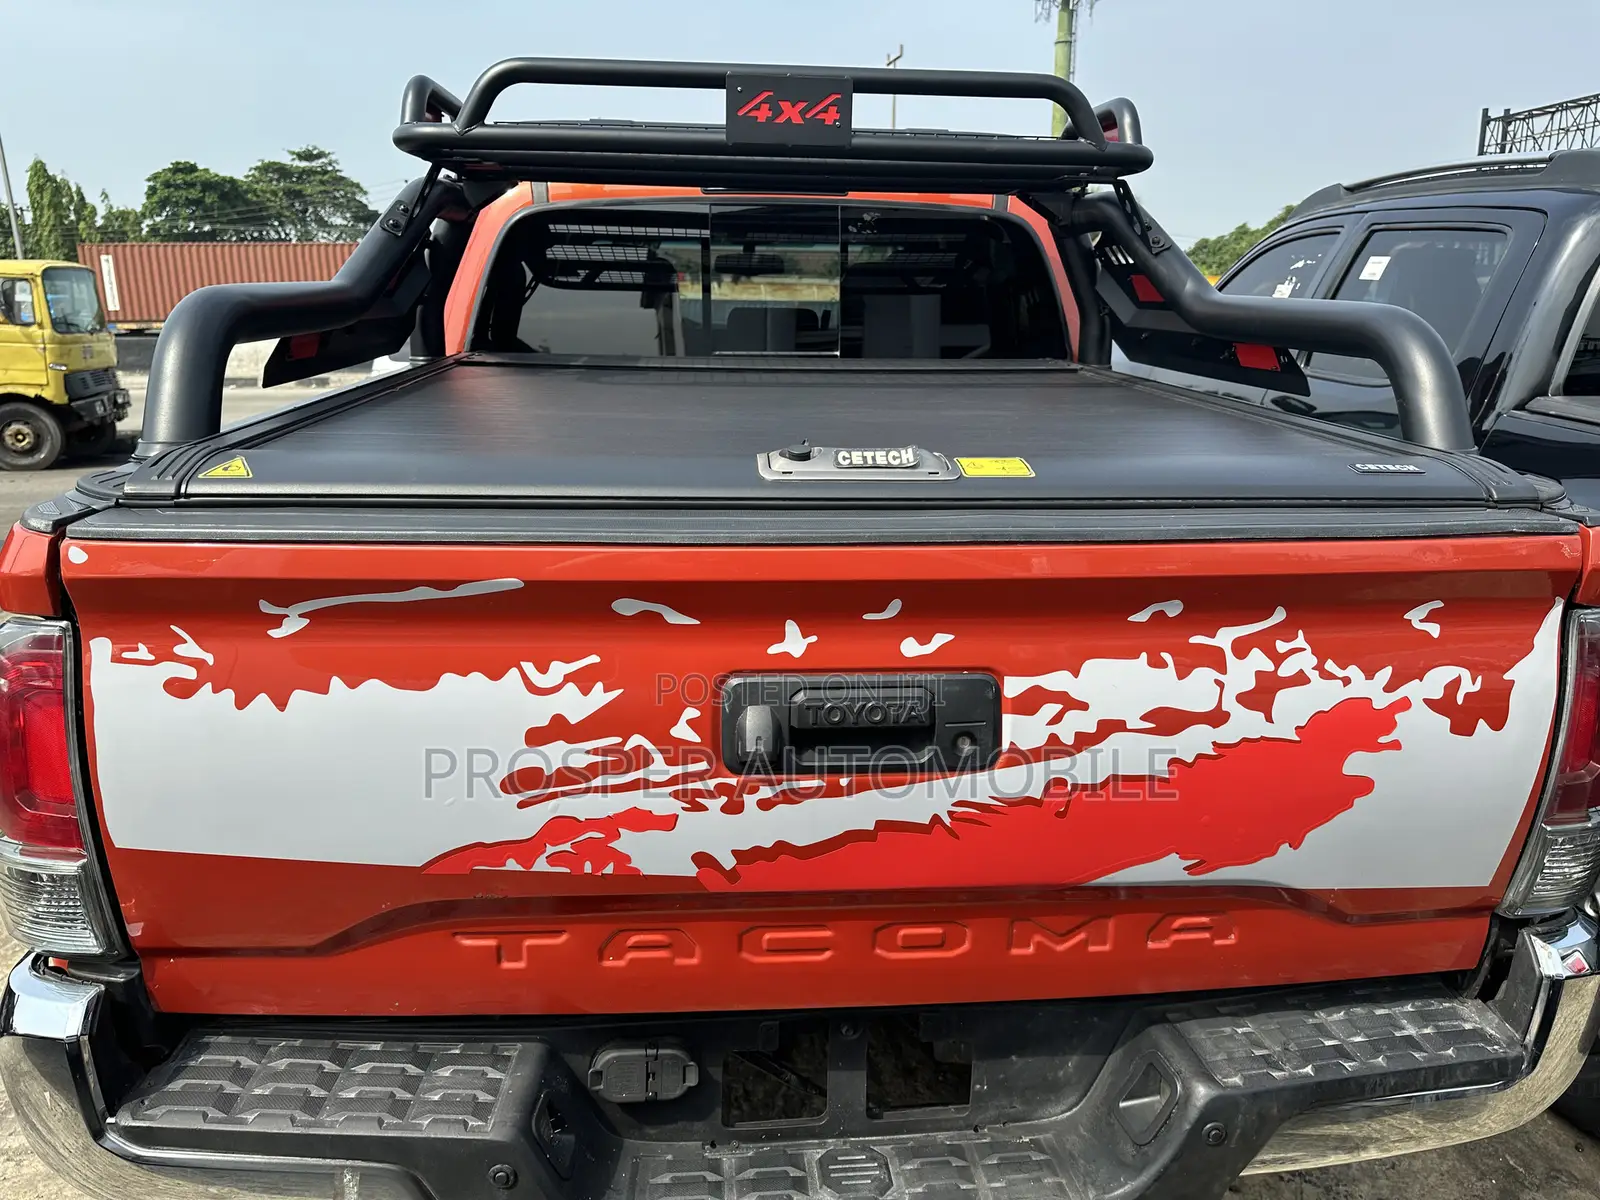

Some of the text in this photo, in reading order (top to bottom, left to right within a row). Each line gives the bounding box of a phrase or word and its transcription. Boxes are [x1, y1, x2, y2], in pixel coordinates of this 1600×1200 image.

[837, 448, 915, 466] CETECH
[804, 701, 926, 726] TOYOTA
[452, 911, 1238, 970] TACOMA
